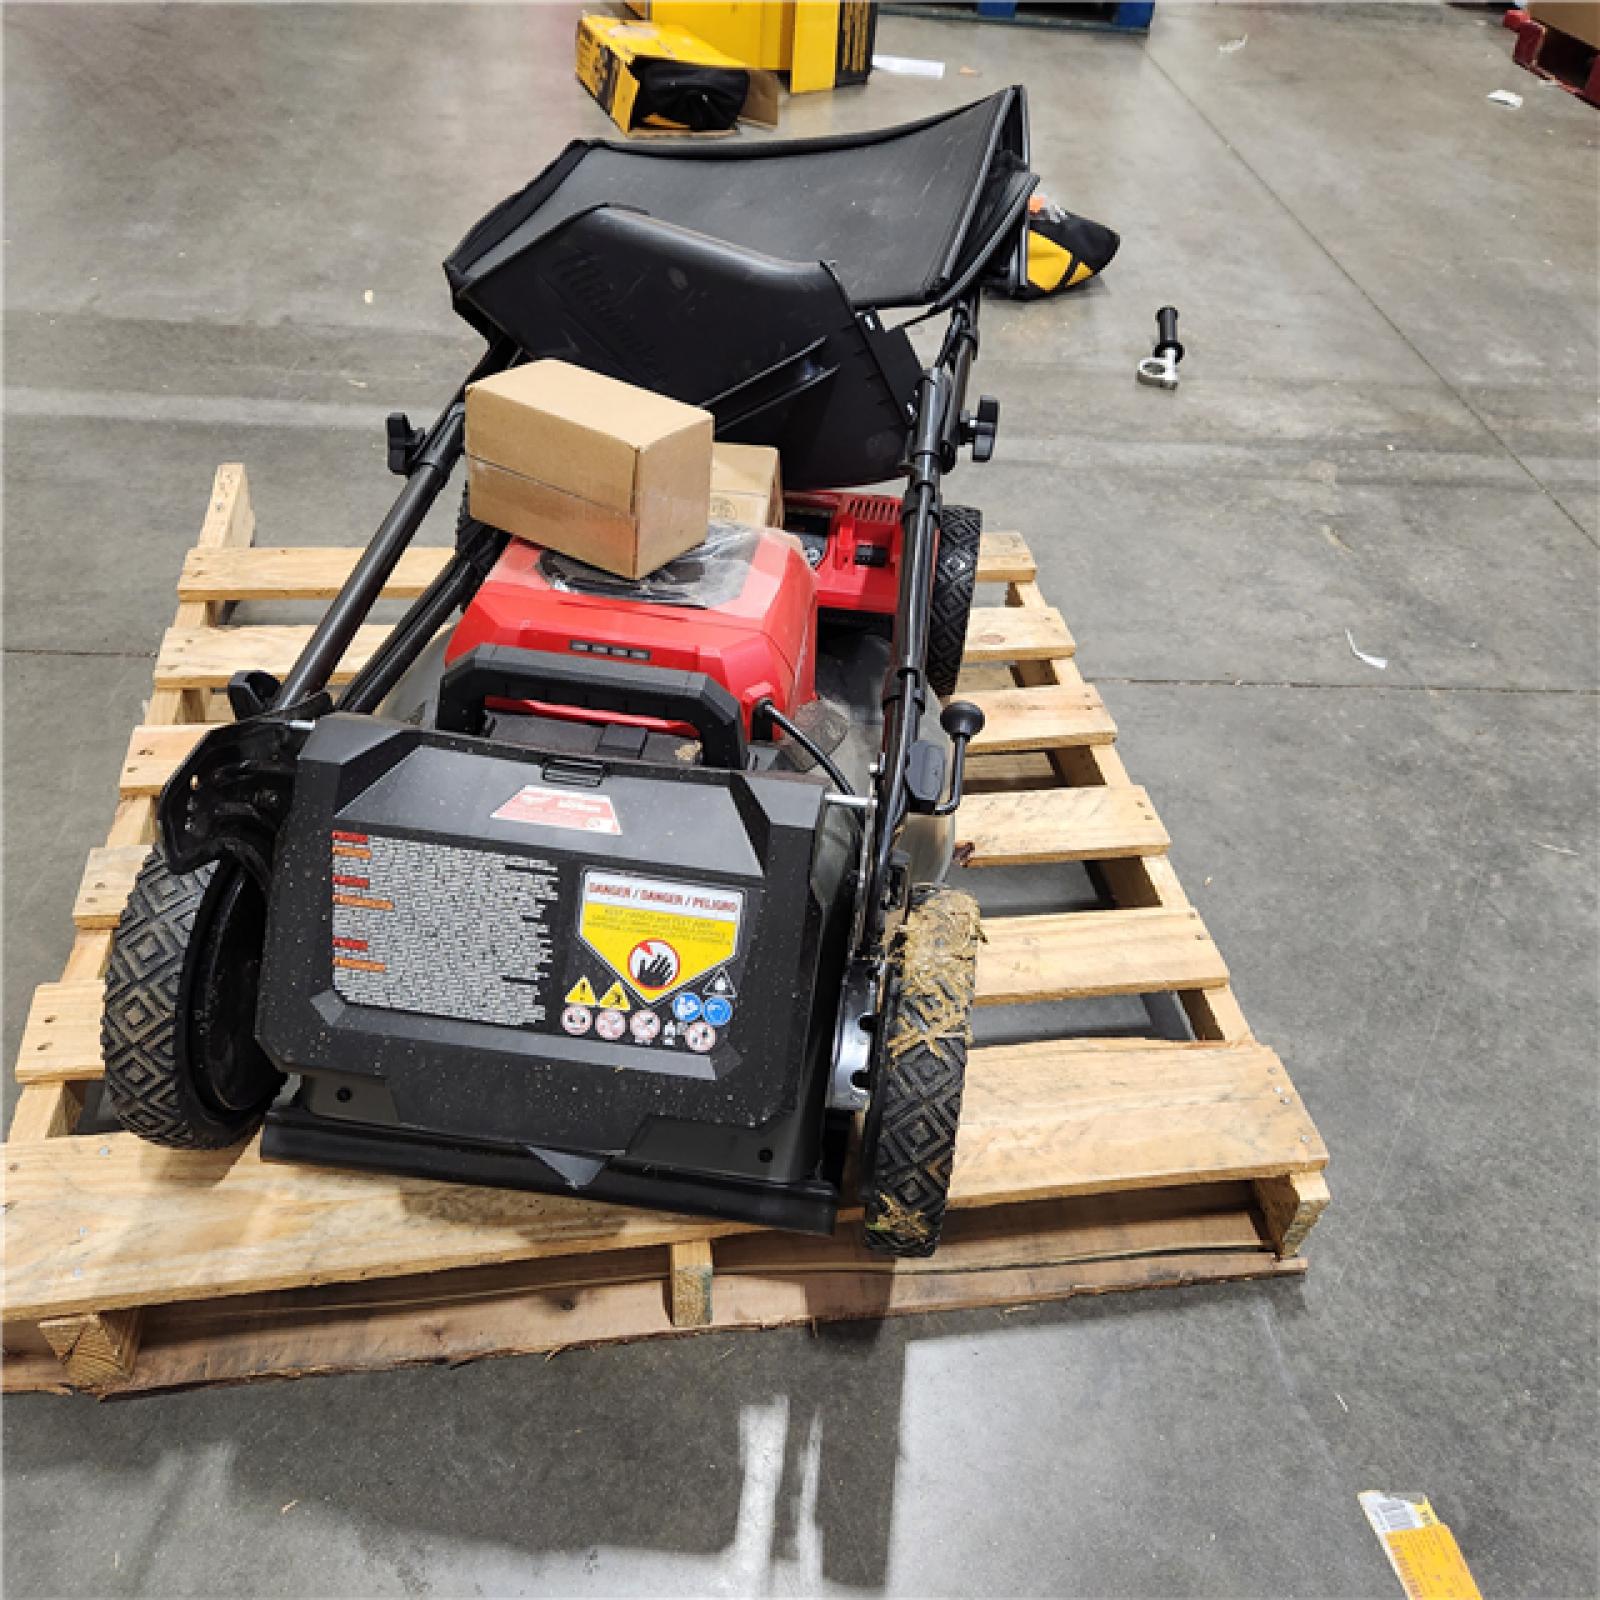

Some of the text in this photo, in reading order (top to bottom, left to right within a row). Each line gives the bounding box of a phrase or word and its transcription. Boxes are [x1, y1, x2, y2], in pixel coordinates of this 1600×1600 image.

[589, 882, 630, 897] DANGER
[639, 890, 683, 905] DANGER
[692, 897, 737, 912] PELIGRO
